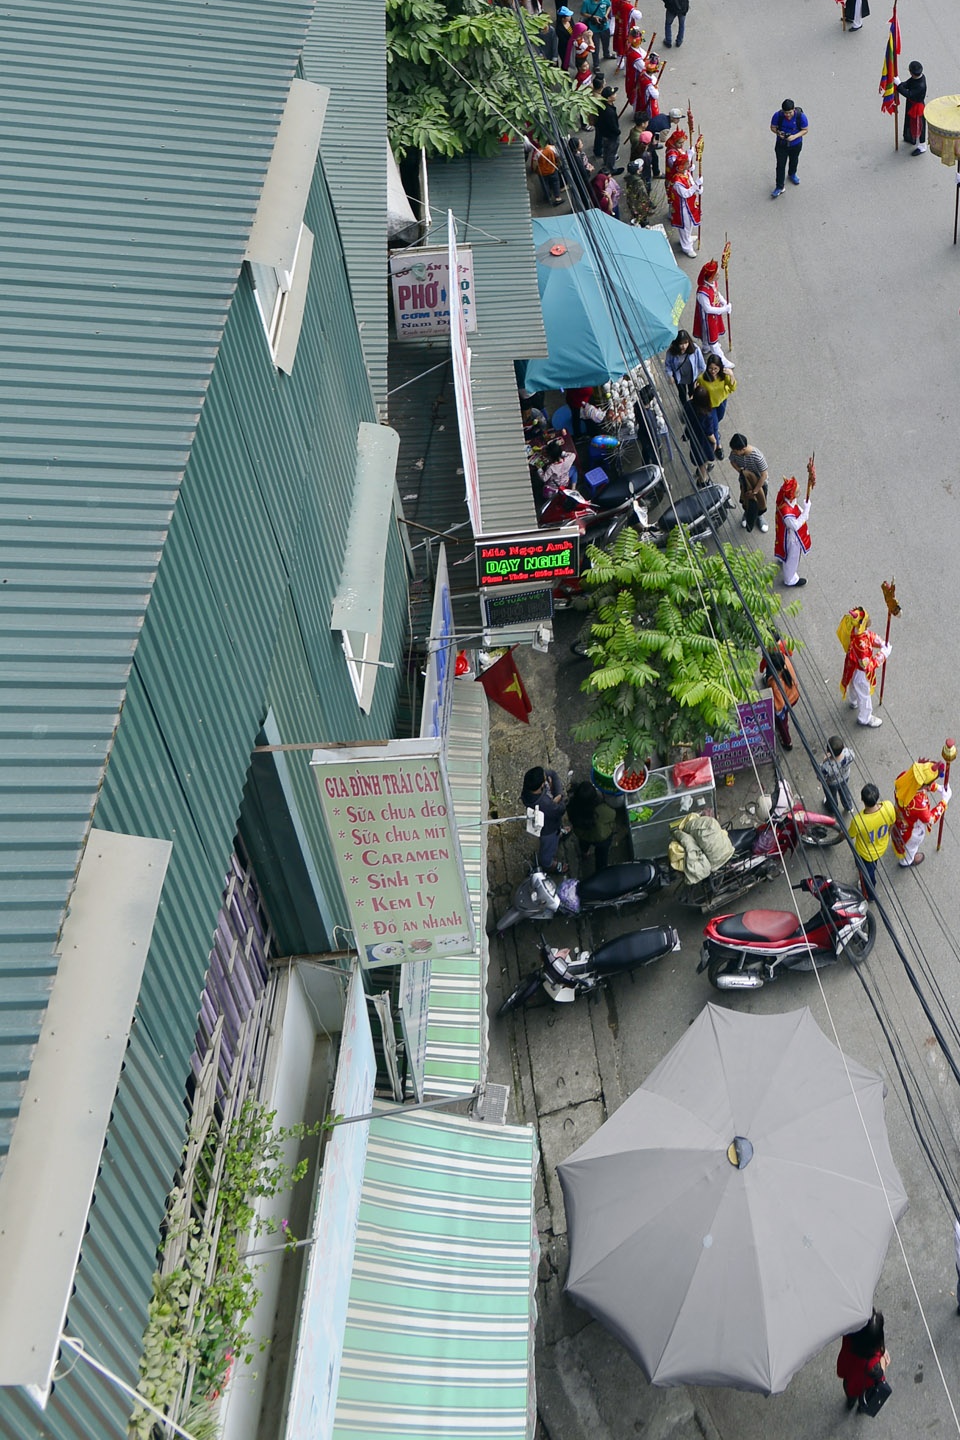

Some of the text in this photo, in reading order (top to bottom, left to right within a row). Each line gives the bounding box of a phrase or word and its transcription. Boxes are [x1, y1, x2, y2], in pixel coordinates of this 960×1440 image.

[398, 273, 440, 311] PHỞ
[401, 312, 431, 320] CƠM
[401, 321, 432, 329] Nam
[509, 545, 543, 556] Ngọc
[545, 541, 573, 551] Anh
[486, 559, 520, 574] DẠY
[325, 766, 440, 799] GIA ĐÌNH TRÁI CÂY
[869, 824, 889, 844] 10
